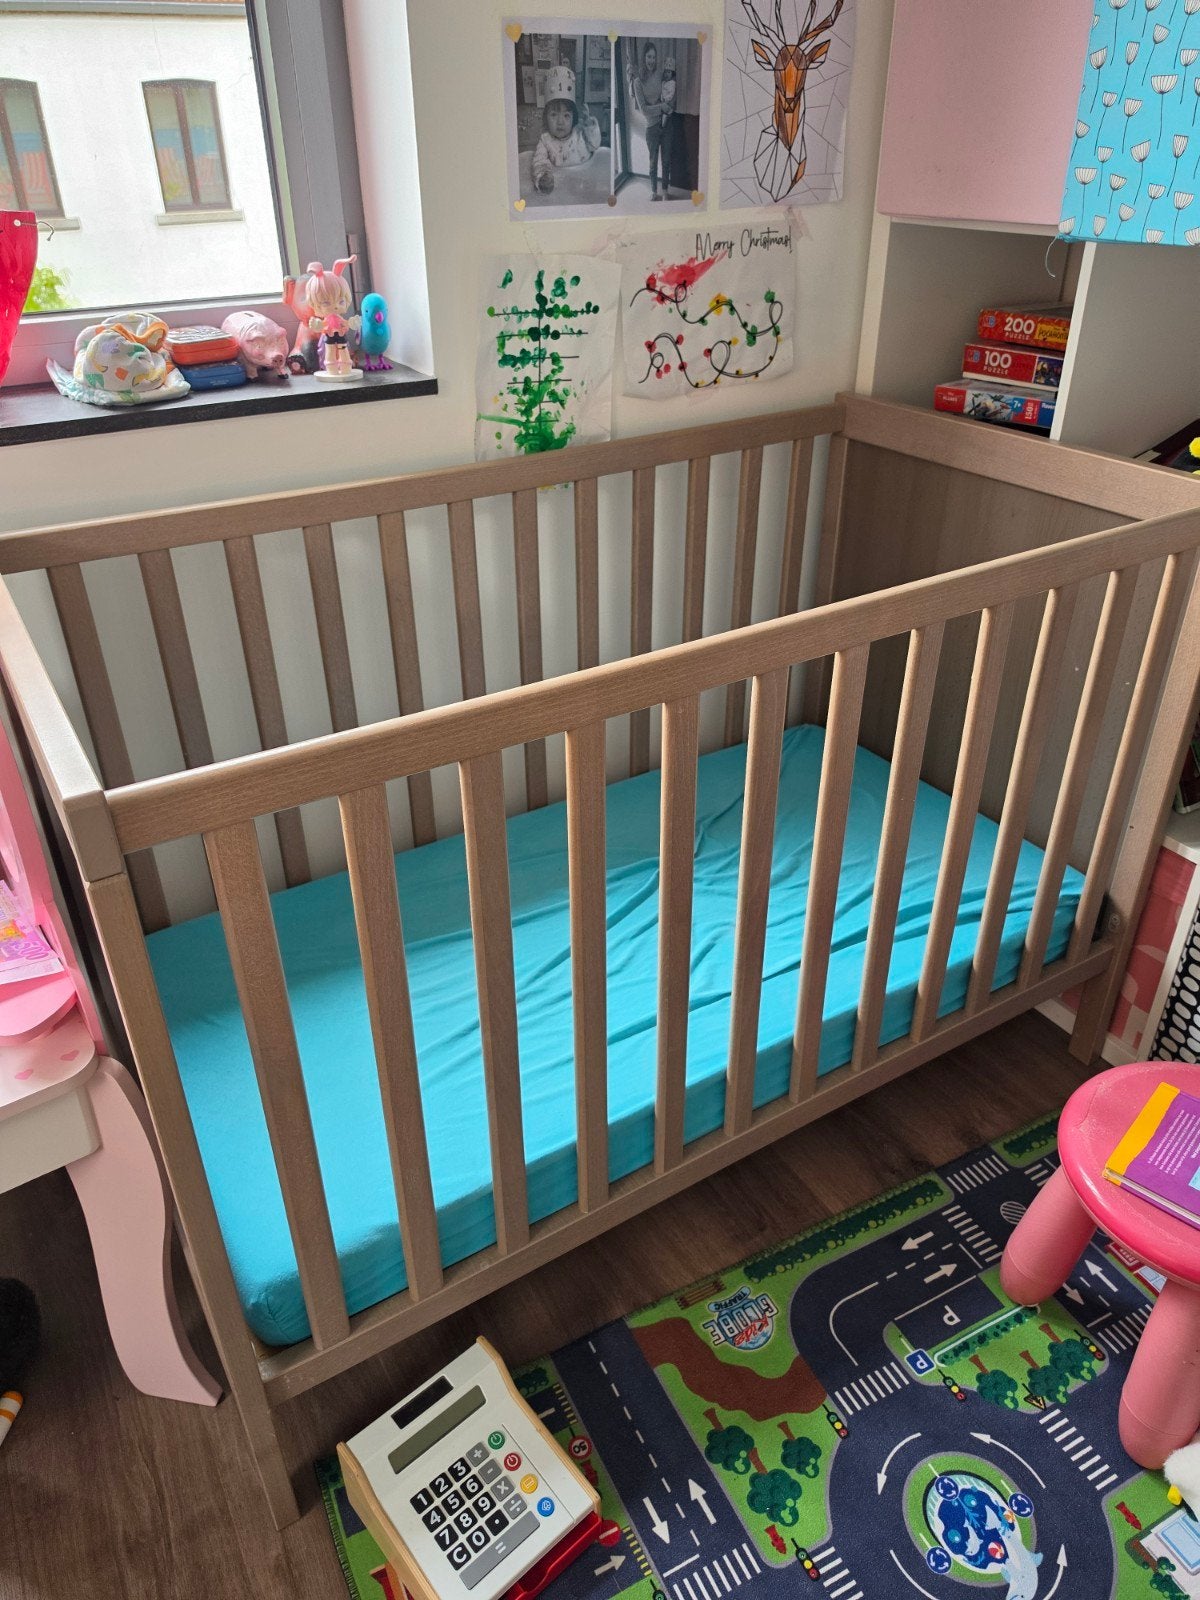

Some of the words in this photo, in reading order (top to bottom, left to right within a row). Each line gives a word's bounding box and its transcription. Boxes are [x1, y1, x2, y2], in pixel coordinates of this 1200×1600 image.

[695, 232, 735, 261] Merry
[740, 225, 793, 257] Christmas!
[1004, 316, 1035, 335] 200
[1005, 331, 1031, 341] PUZZLE
[984, 350, 1012, 369] 100
[983, 365, 1009, 376] PUZZLE
[714, 1290, 747, 1311] TRAFFIC
[733, 1314, 769, 1347] Kids
[915, 1355, 928, 1370] P
[573, 1440, 587, 1454] 50
[417, 1492, 430, 1506] 1
[435, 1477, 449, 1492] 2
[453, 1459, 468, 1475] 3
[429, 1511, 441, 1525] 4
[447, 1494, 460, 1509] 5
[467, 1478, 480, 1493] 6
[439, 1529, 451, 1545] 7
[460, 1513, 473, 1527] 8
[478, 1496, 491, 1511] 9
[452, 1547, 468, 1563] C
[472, 1531, 485, 1546] 0
